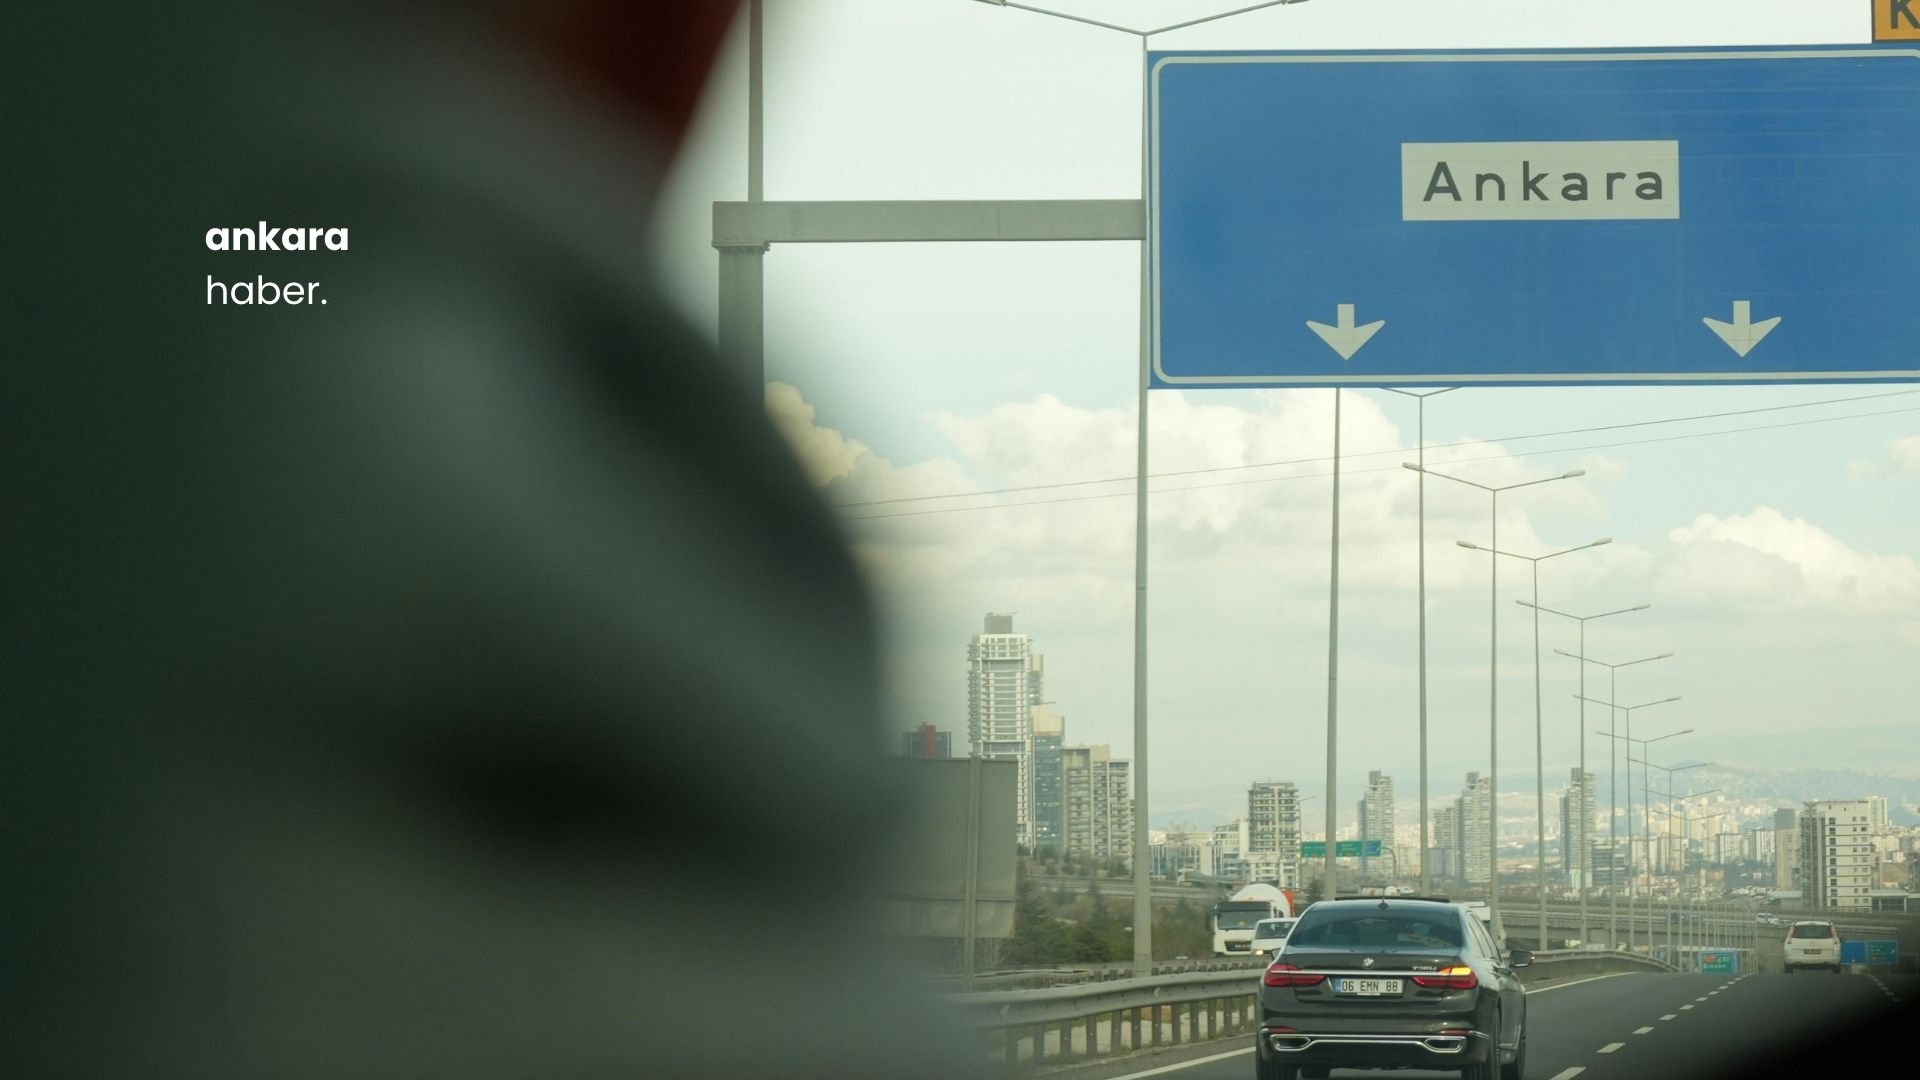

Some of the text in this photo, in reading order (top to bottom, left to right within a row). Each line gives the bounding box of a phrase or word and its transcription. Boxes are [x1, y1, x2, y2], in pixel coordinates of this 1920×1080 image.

[1422, 160, 1663, 202] Ankara
[1341, 980, 1399, 992] 06 EMN 88
